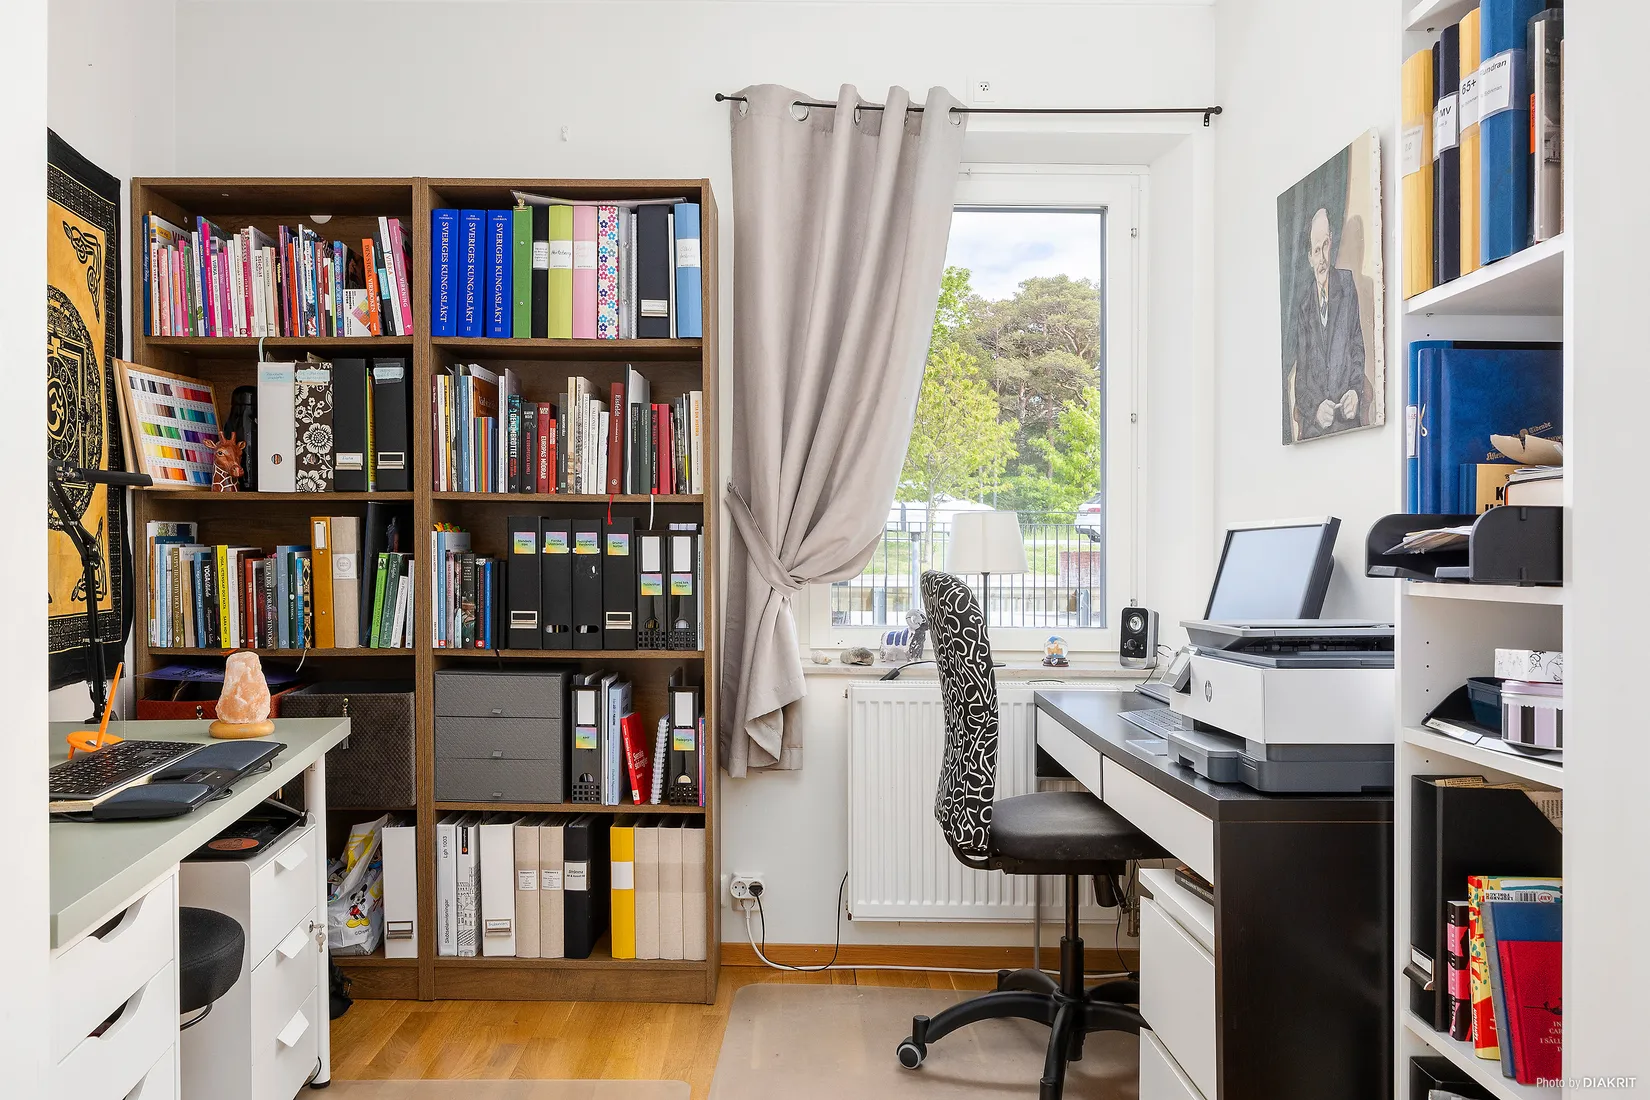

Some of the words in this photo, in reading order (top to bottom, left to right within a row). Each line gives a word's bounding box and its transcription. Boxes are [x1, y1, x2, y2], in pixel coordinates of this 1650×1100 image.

[1462, 79, 1476, 94] 65+
[400, 278, 408, 307] VIRKNING
[466, 266, 474, 323] KUNGASLÄKT
